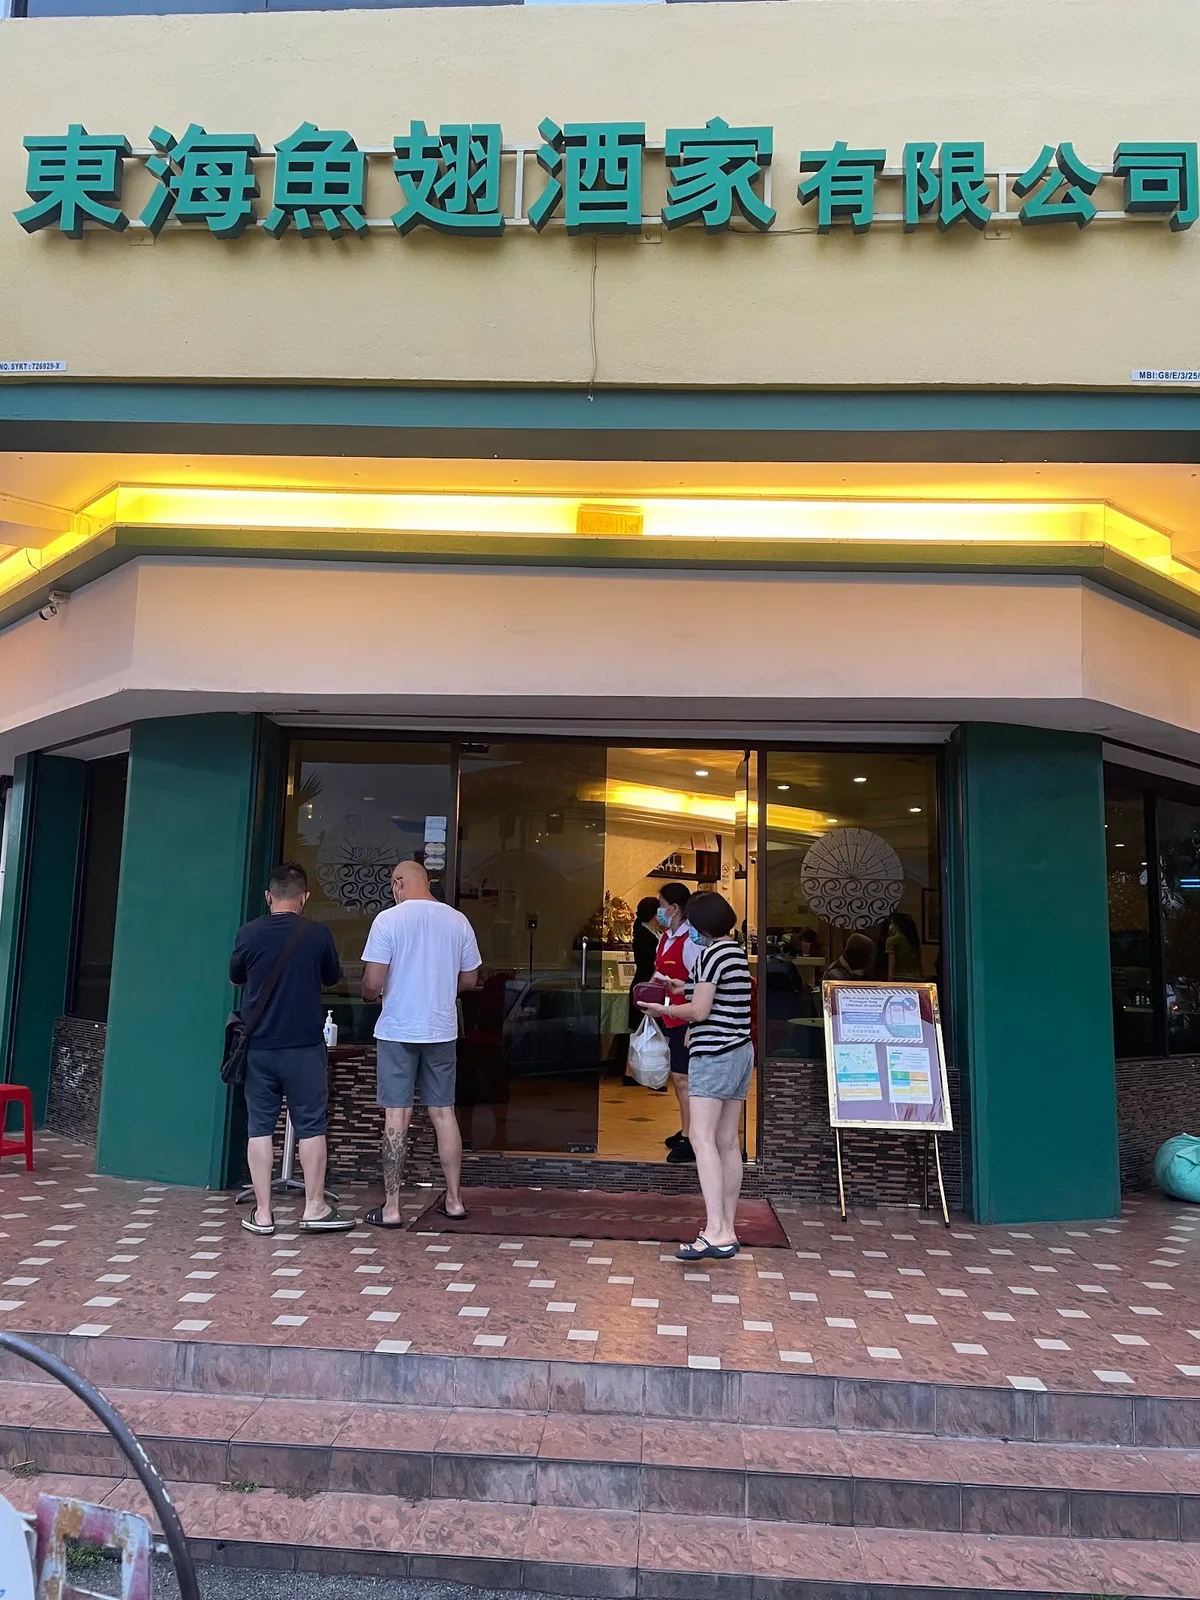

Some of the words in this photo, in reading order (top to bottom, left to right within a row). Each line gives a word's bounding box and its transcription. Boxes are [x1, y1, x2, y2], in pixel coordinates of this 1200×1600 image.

[13, 116, 1199, 240] 東海魚翅酒家有限公司
